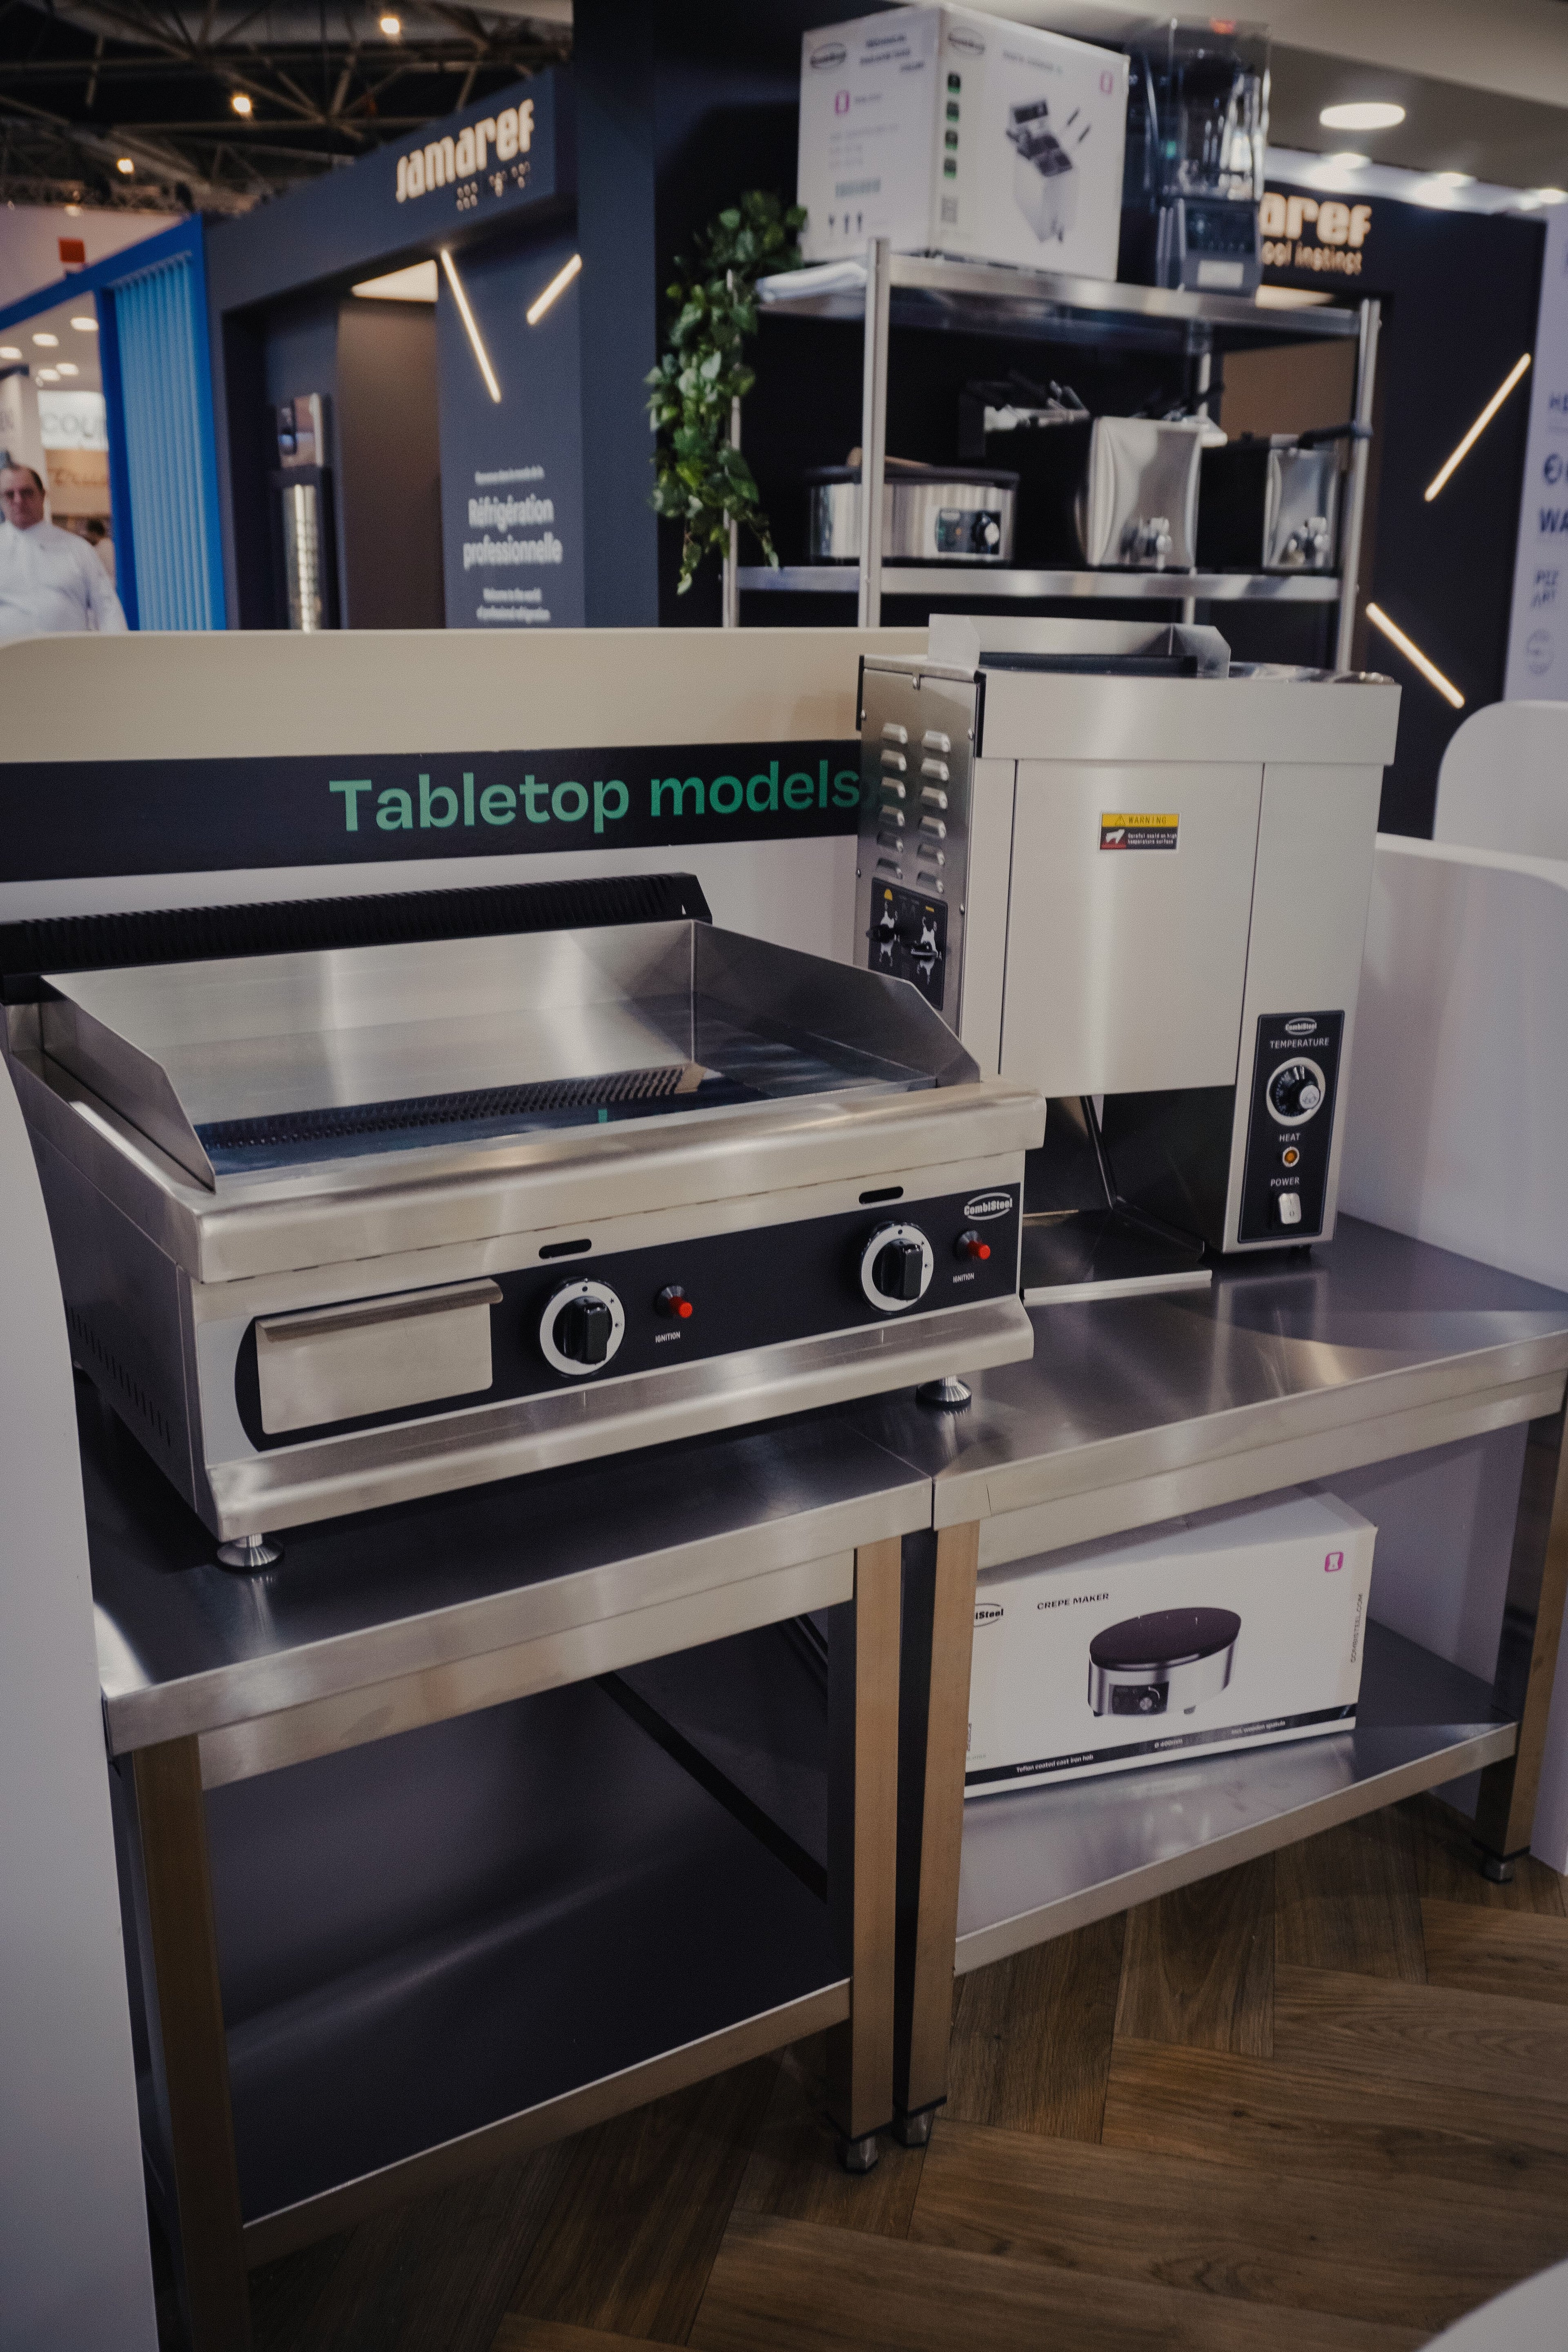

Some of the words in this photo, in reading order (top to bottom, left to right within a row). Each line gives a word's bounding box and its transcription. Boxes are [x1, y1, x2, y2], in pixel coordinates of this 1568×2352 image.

[329, 772, 629, 833] Tabletop
[651, 758, 860, 817] models
[1129, 816, 1167, 824] WARNING
[1285, 1022, 1317, 1031] CombiSteel
[1270, 1038, 1330, 1049] TEMPERATURE
[1279, 1133, 1301, 1143] HEAT
[1271, 1177, 1300, 1186] POWER
[964, 1197, 1013, 1216] CombiSteel
[953, 1272, 974, 1283] IGNITION
[655, 1331, 681, 1343] IGNITION
[1037, 1598, 1070, 1610] CREPE
[1073, 1593, 1109, 1604] MAKER
